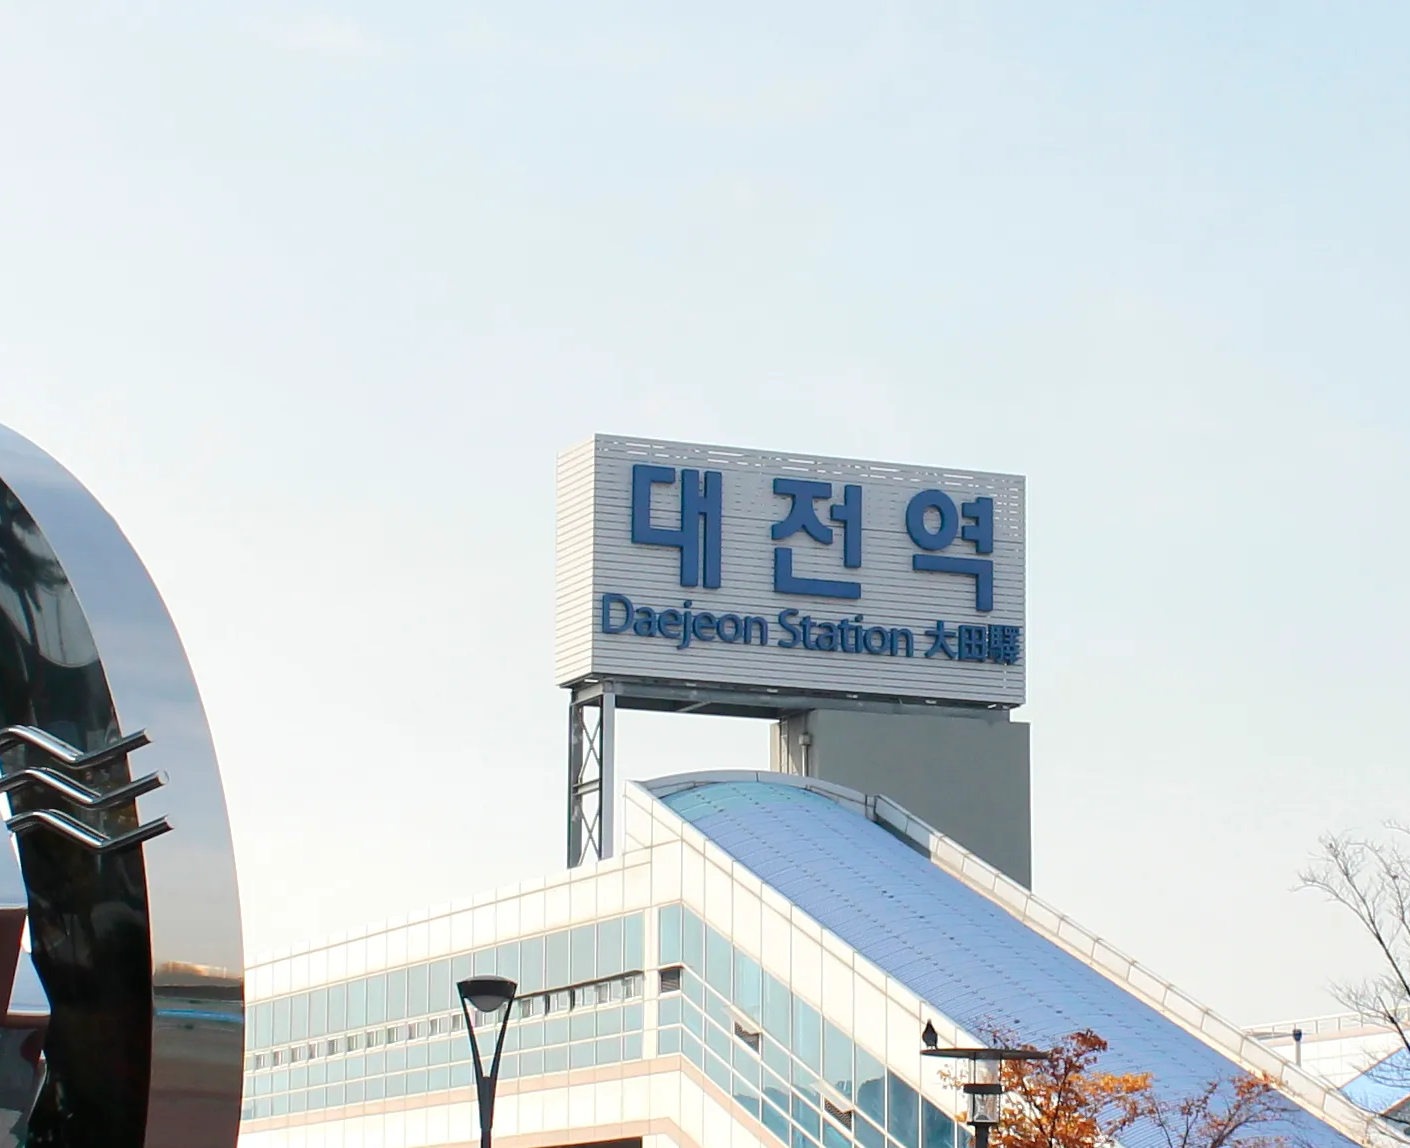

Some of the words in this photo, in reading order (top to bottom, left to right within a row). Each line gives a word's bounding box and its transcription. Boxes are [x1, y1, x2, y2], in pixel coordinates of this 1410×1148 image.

[631, 464, 994, 612] 대전역
[602, 592, 768, 650] Daejeon
[778, 608, 914, 657] Station
